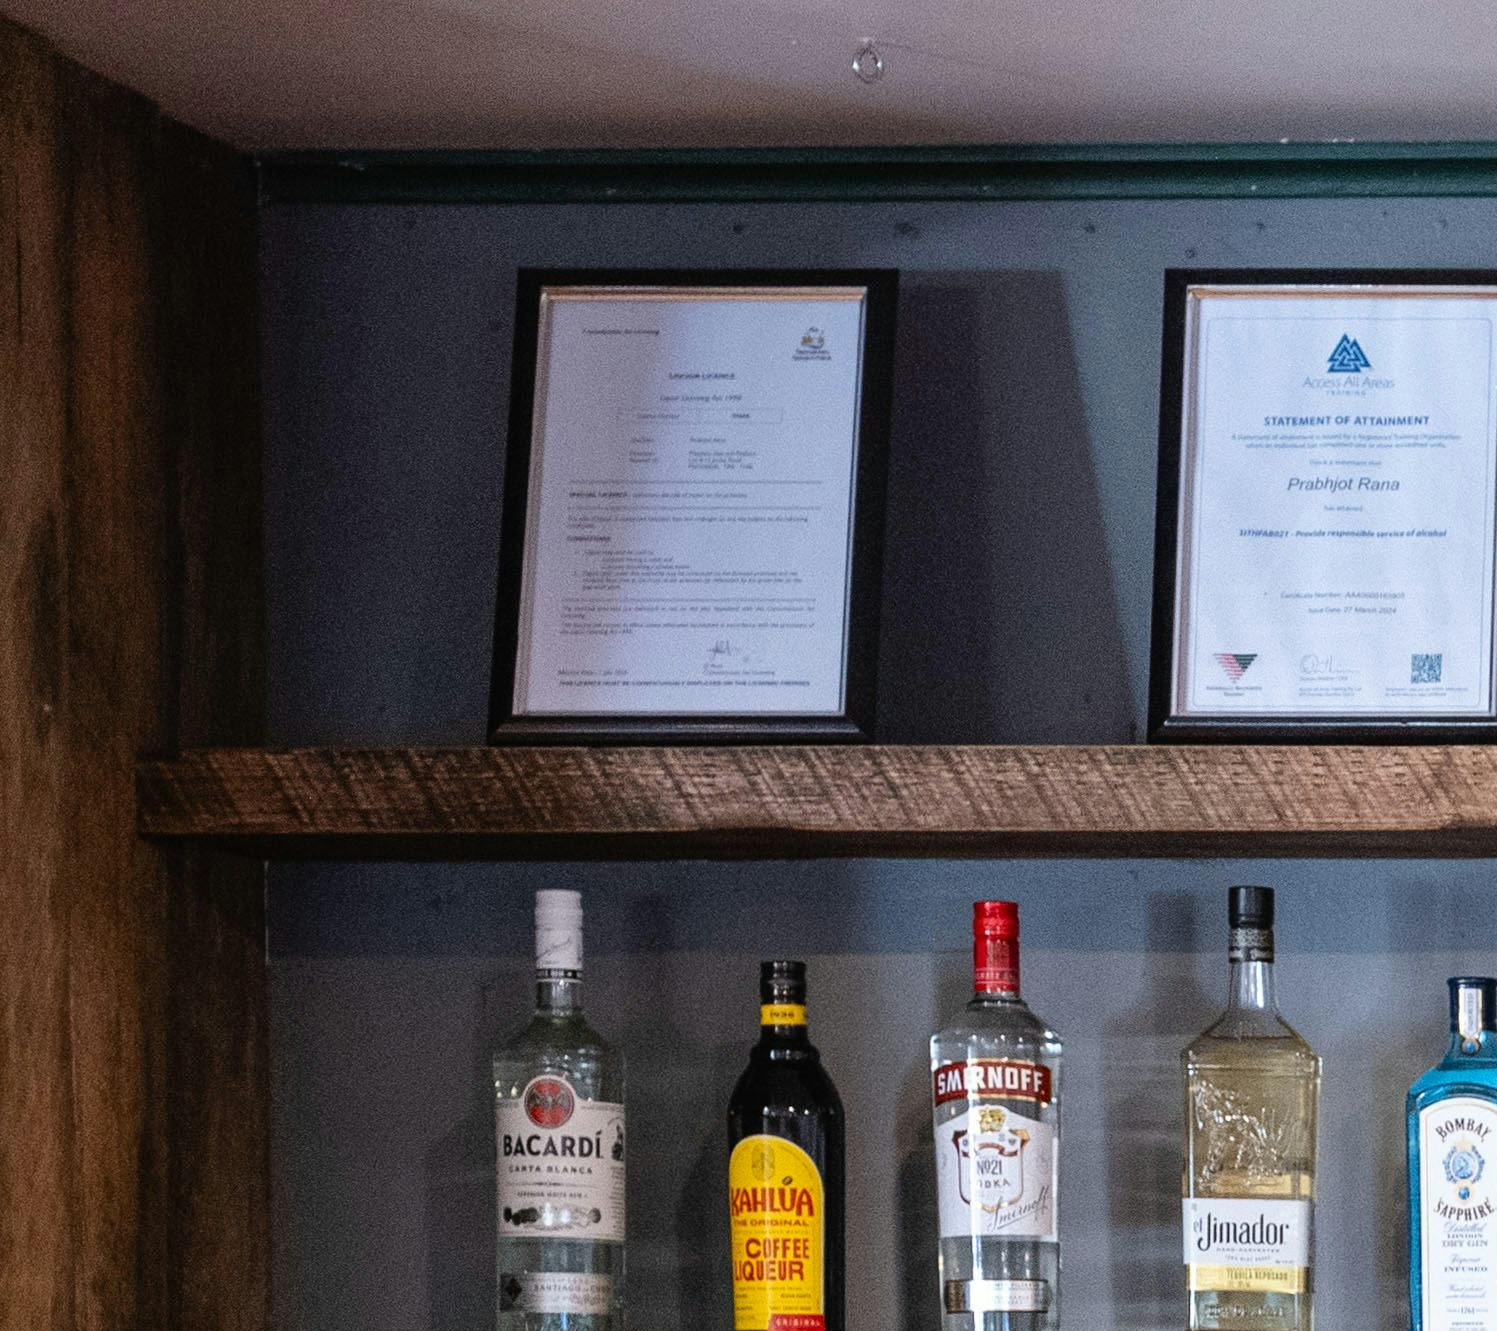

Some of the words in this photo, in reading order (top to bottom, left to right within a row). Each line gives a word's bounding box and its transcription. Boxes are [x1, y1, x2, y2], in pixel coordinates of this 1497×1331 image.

[1264, 415, 1331, 427] STATEMENT
[1335, 415, 1351, 426] OF
[1354, 415, 1430, 426] ATTAINMENT
[1287, 477, 1353, 492] Prabhjot
[1358, 477, 1400, 492] Rana
[1435, 1117, 1493, 1143] BOMBAY
[503, 1131, 602, 1159] BACARDÍ
[546, 1165, 593, 1175] BLANCA
[1432, 1198, 1496, 1222] SAPPHIRE
[750, 1219, 809, 1227] ORIGINAL
[1193, 1217, 1203, 1233] el
[1197, 1212, 1290, 1252] Jimador
[745, 1237, 810, 1259] COFFEE
[735, 1260, 804, 1281] LIQUEUR
